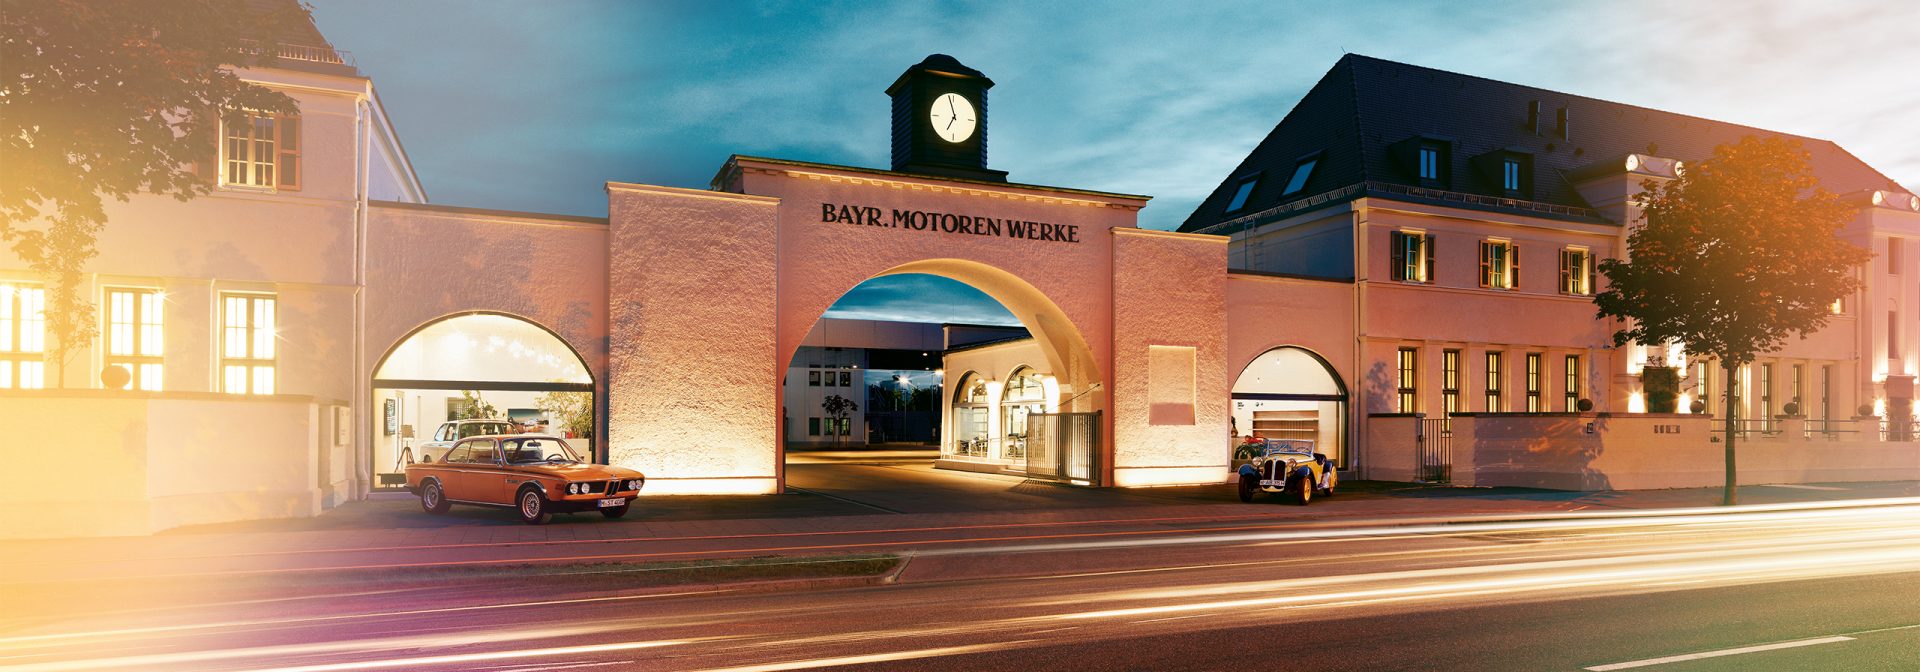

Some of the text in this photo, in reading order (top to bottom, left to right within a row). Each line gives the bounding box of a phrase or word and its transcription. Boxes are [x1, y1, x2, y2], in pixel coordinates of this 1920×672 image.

[822, 203, 1080, 243] BAYR. MOTOREN WERKE
